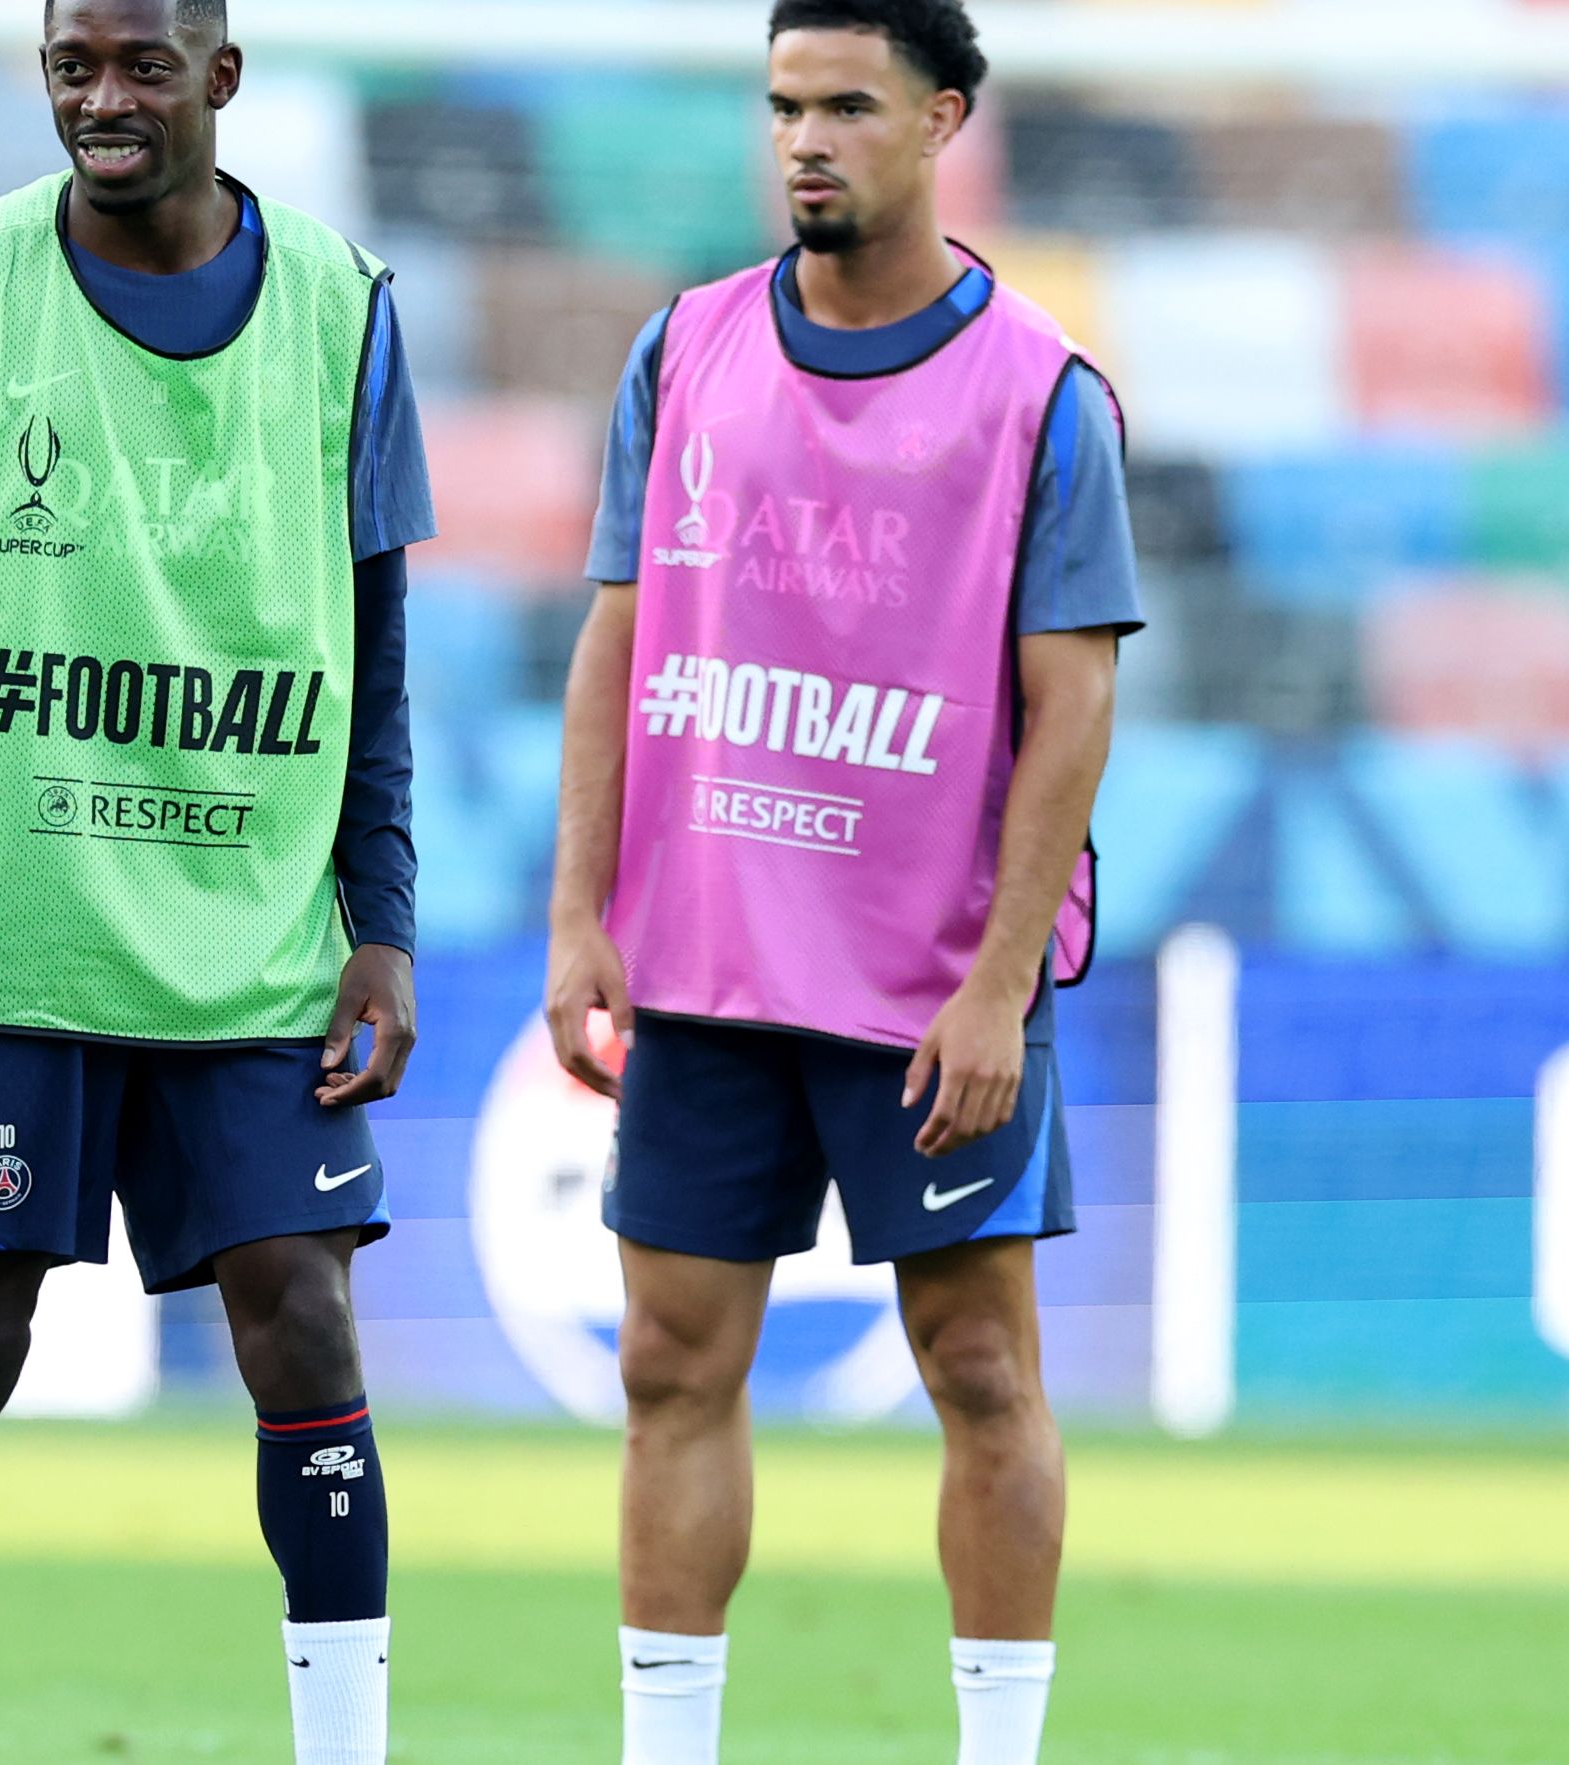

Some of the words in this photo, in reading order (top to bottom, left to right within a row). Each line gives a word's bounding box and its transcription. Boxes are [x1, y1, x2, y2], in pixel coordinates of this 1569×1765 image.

[734, 556, 910, 608] AIRWAYS
[90, 794, 253, 836] RESPECT
[710, 790, 863, 842] RESPECT
[301, 1466, 320, 1476] BV
[321, 1458, 366, 1476] SPORT
[329, 1491, 350, 1518] 10
